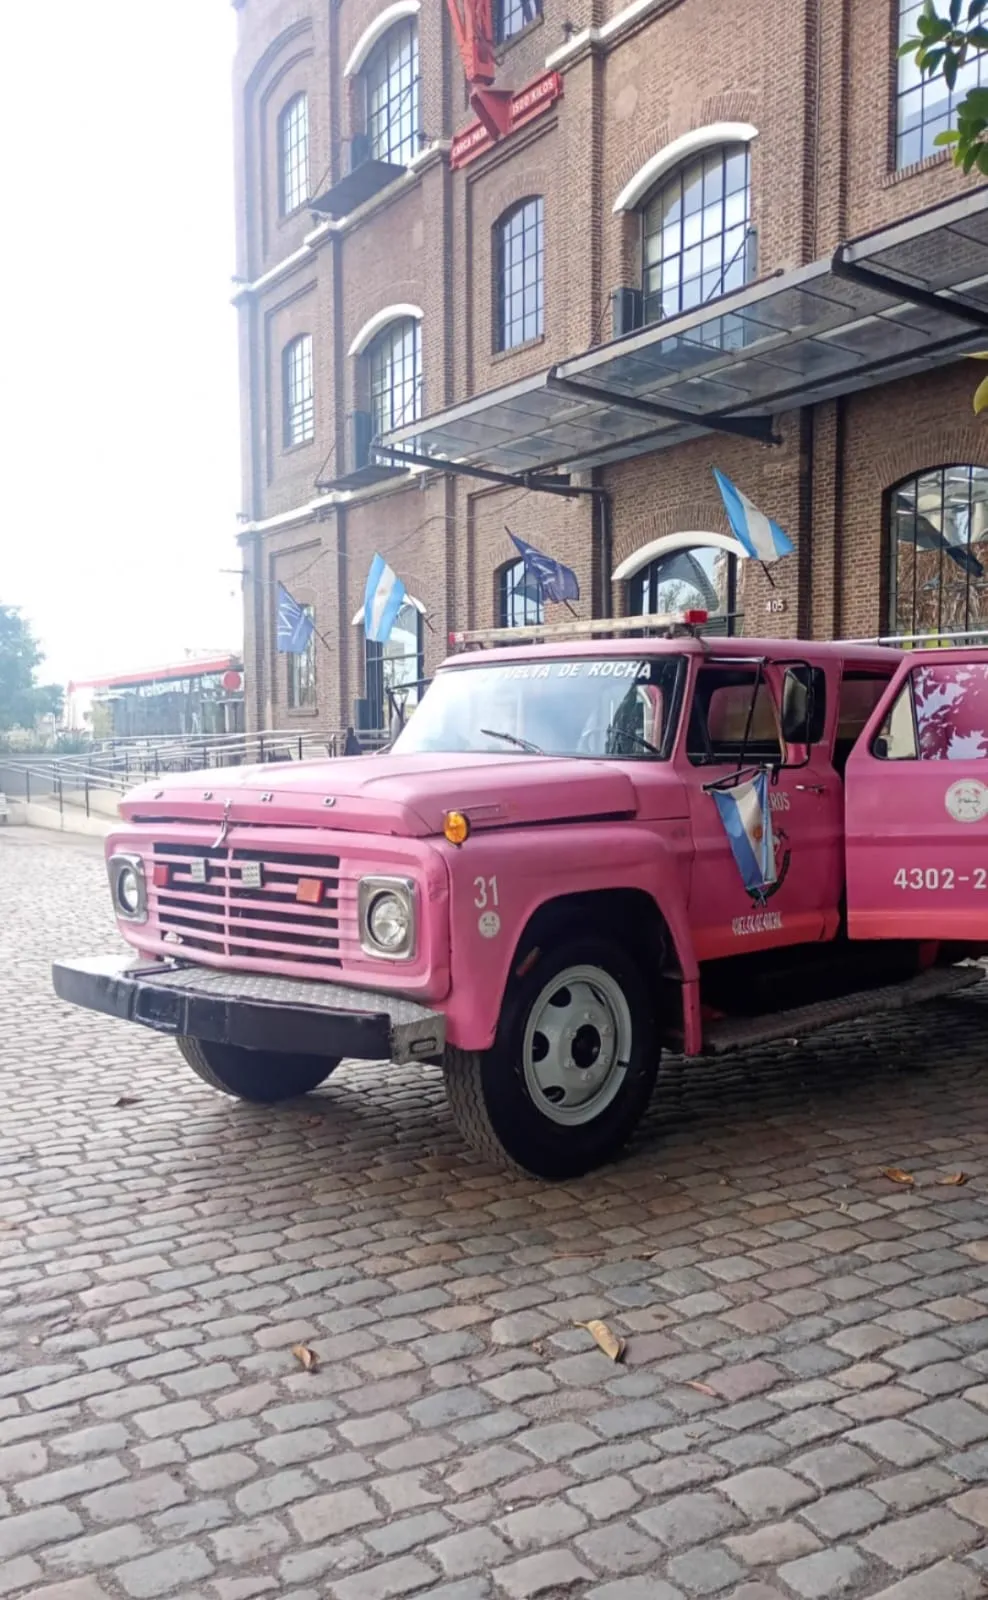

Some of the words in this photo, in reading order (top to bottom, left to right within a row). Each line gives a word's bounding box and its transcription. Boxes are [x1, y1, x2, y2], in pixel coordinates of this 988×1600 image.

[499, 665, 551, 680] UELTA
[558, 662, 584, 677] DE
[588, 660, 651, 679] ROCHA
[894, 868, 987, 890] 4302-2
[473, 876, 498, 908] 31
